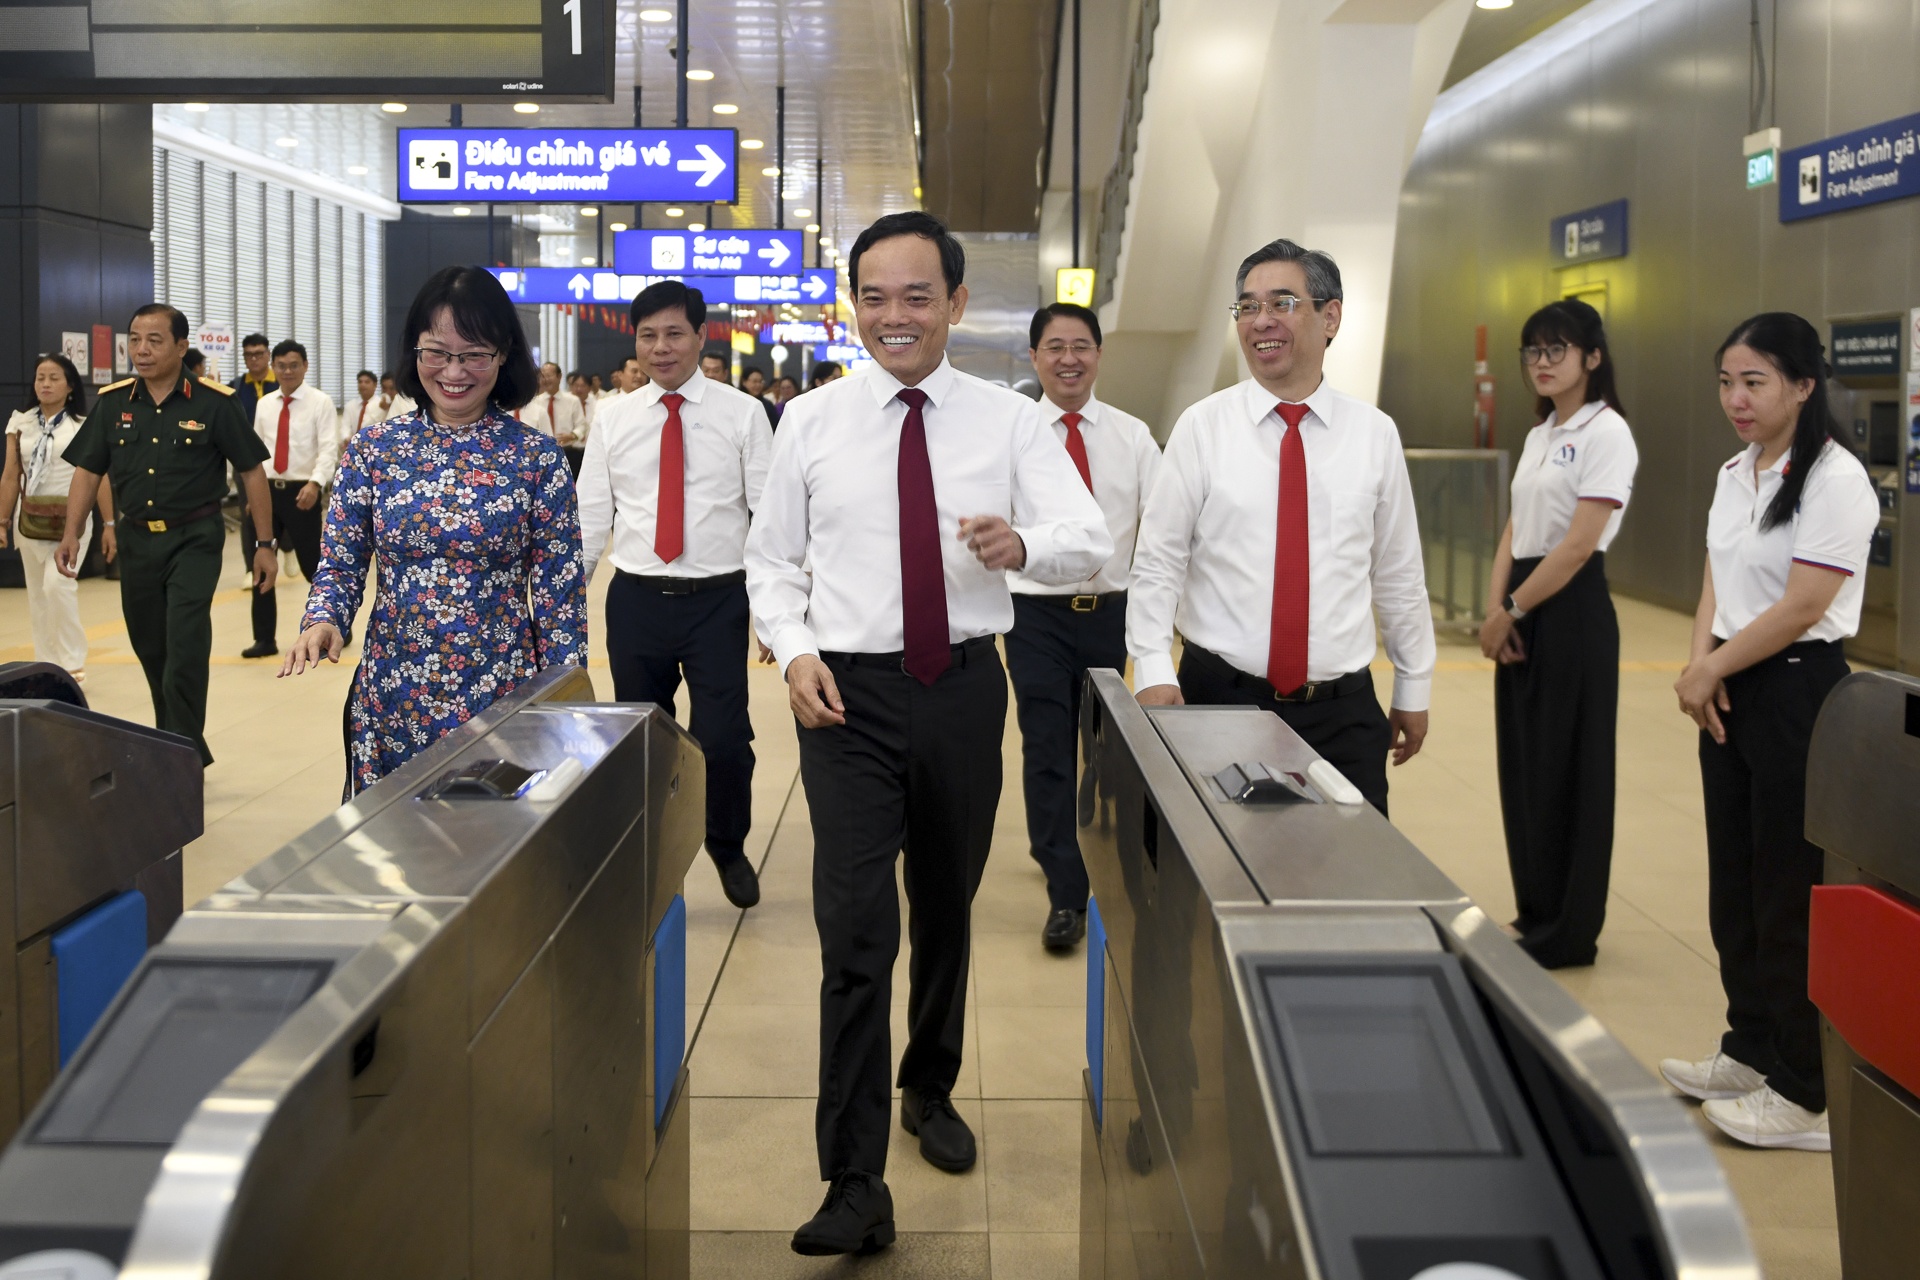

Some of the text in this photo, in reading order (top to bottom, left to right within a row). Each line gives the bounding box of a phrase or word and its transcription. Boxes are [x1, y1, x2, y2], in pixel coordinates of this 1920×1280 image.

[563, 0, 582, 55] 1
[465, 138, 671, 172] Điều chỉnh giá vé
[1828, 145, 1855, 174] Điều
[1857, 137, 1892, 167] chỉnh
[1894, 130, 1916, 164] giá
[464, 171, 609, 194] Fare Adjustment
[1827, 169, 1899, 199] Fare Adjustment
[217, 335, 230, 343] 04
